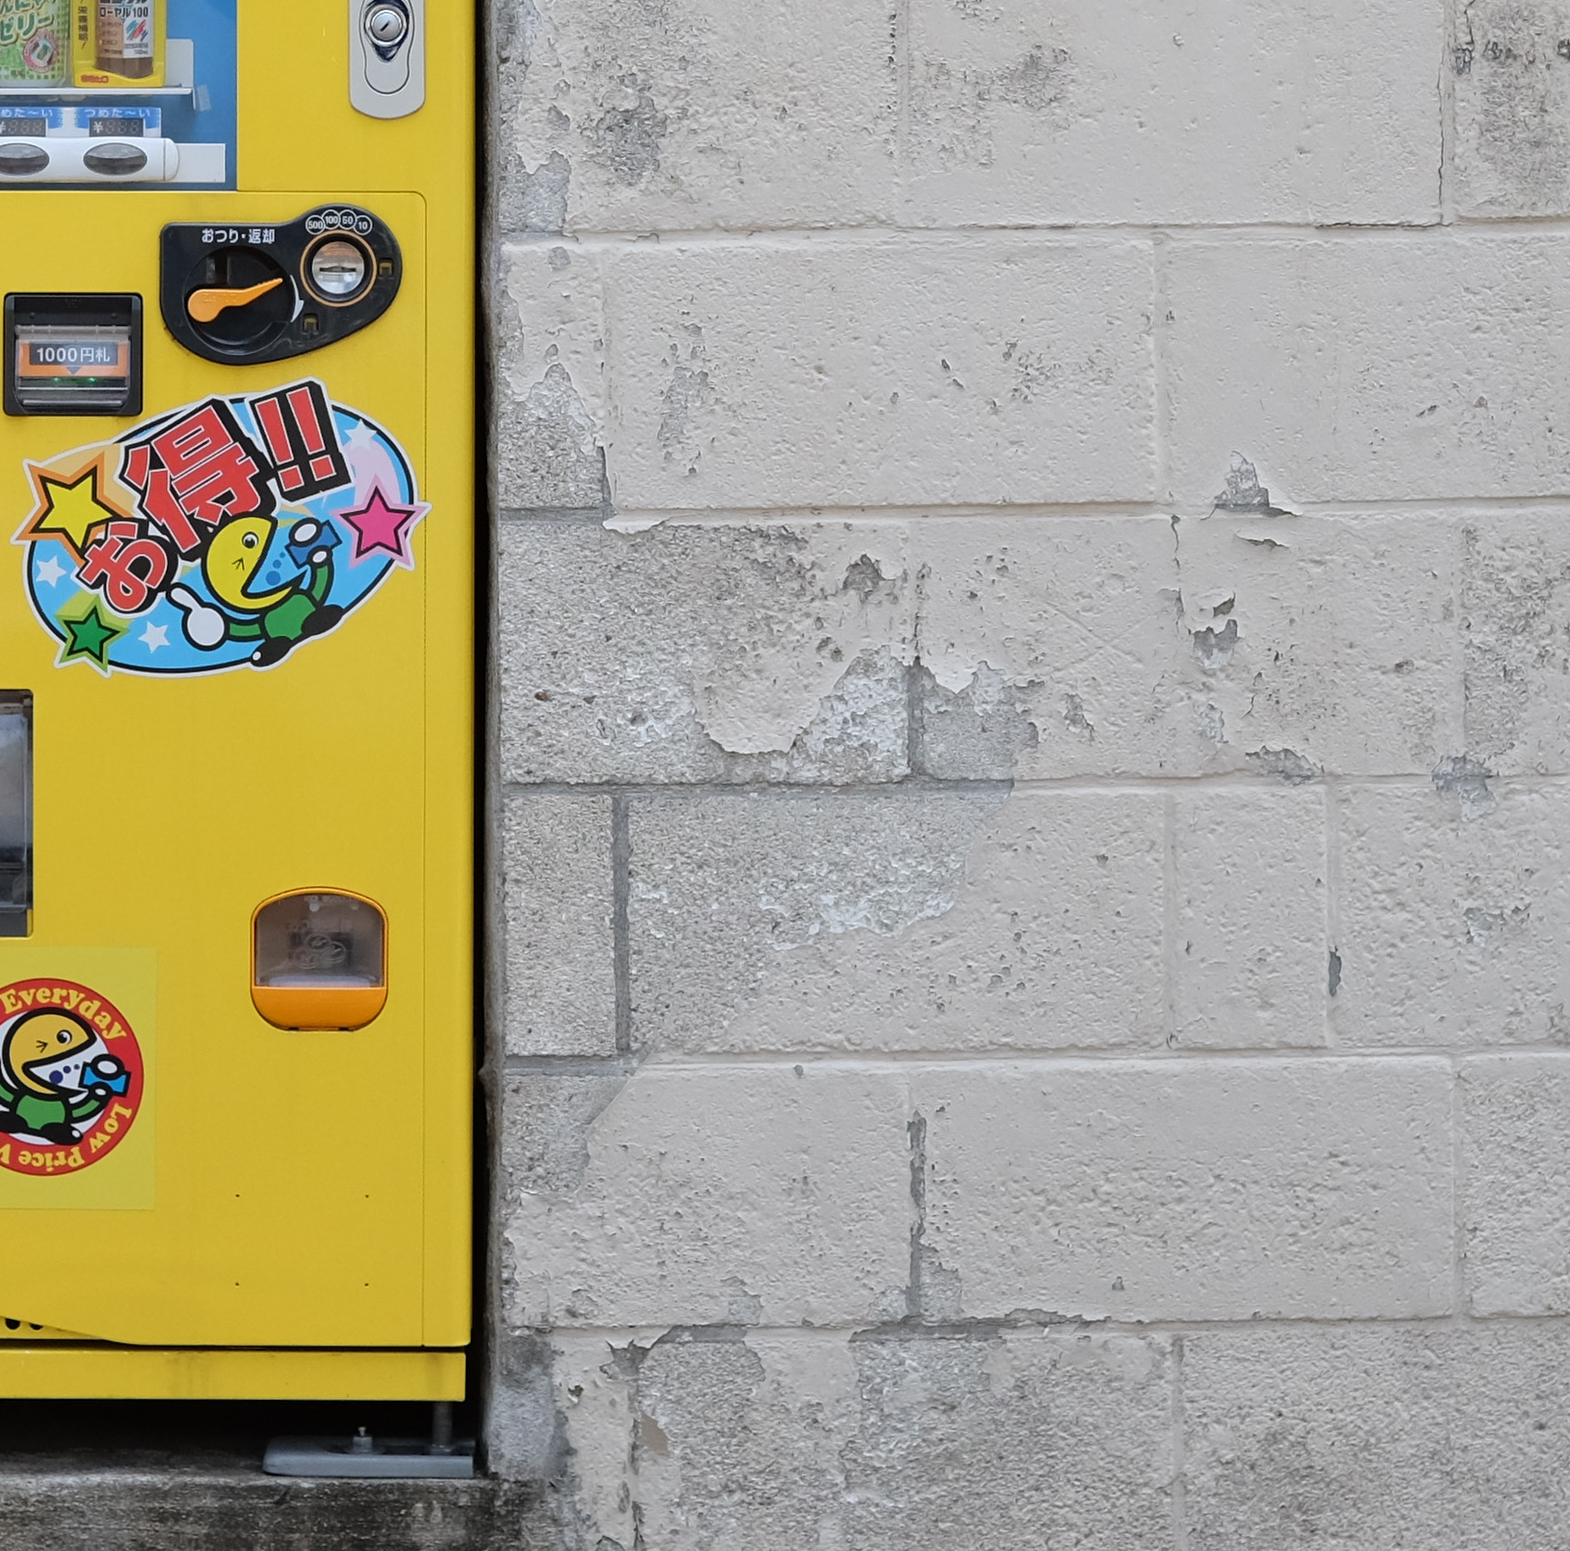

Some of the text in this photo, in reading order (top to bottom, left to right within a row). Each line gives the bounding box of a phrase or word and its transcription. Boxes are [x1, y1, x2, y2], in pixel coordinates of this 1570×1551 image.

[308, 221, 323, 229] 500
[325, 215, 338, 224] 100
[342, 216, 353, 224] 50
[202, 228, 275, 245] おつり・返却
[35, 346, 111, 364] 1000円札
[79, 386, 340, 612] お得!!
[89, 1103, 133, 1154] Low
[18, 1146, 86, 1172] Price
